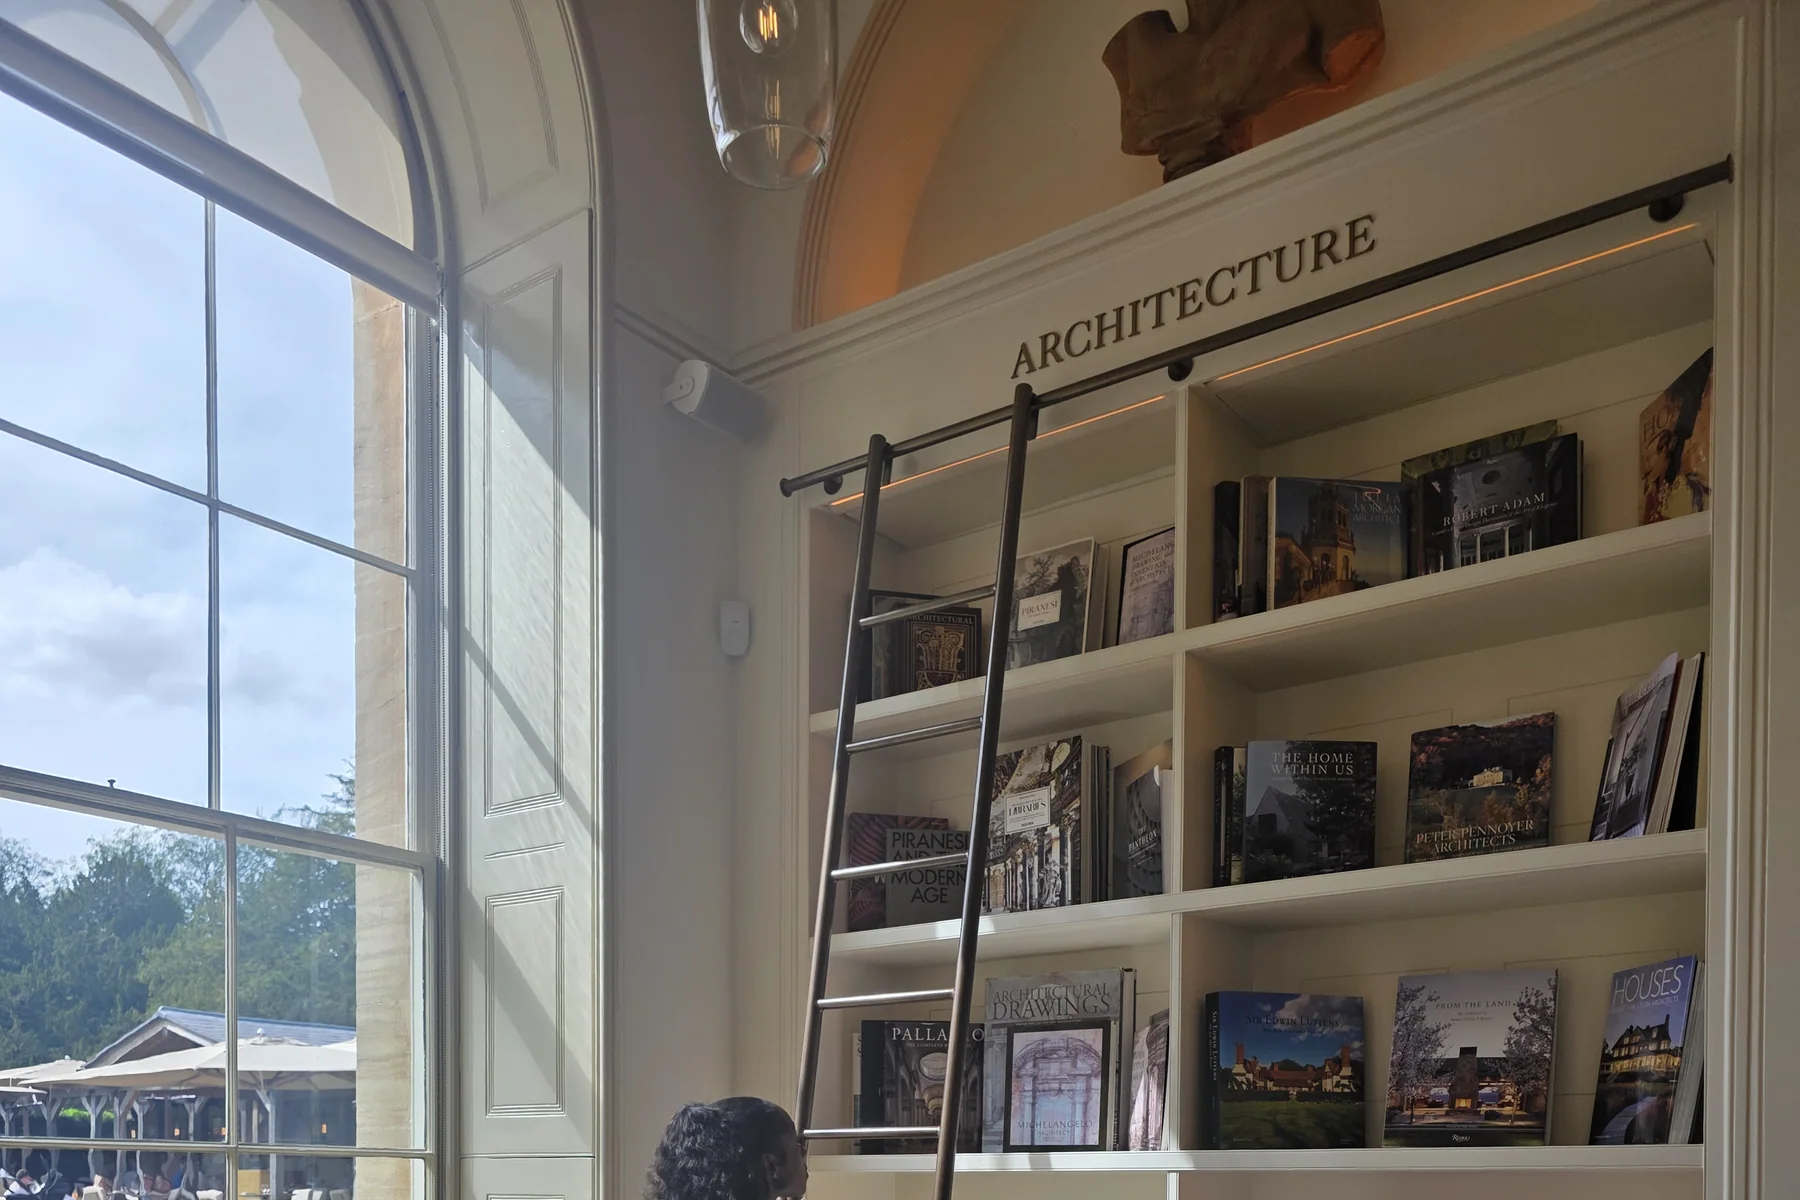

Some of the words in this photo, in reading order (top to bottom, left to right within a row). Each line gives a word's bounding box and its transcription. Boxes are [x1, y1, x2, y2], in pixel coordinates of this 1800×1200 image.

[1011, 214, 1377, 379] ARCHITECTURE
[1353, 502, 1401, 515] MORGAN
[1443, 504, 1499, 527] ROBERT
[1502, 492, 1546, 513] ADAM
[1021, 600, 1058, 616] PIRANESI
[1271, 752, 1302, 764] THE
[1308, 752, 1355, 764] HOME
[1270, 764, 1329, 776] WITHIN
[1335, 764, 1355, 776] US
[892, 831, 968, 850] PIRANESI
[1128, 829, 1158, 853] PANTHEON
[1416, 828, 1457, 845] PETER
[1458, 819, 1535, 839] PENNOYER
[1434, 833, 1517, 853] ARCHITECTS
[910, 886, 949, 905] AGE
[994, 982, 1111, 1003] ARCHITECTURAL
[1612, 964, 1684, 1005] HOUSES
[993, 994, 1111, 1020] DRAWINGS
[1435, 1002, 1461, 1010] FROM
[1464, 1001, 1482, 1009] THE
[1485, 1000, 1511, 1008] LAND
[892, 1027, 985, 1041] PALLAO
[1017, 1119, 1093, 1129] MICHELANGELO
